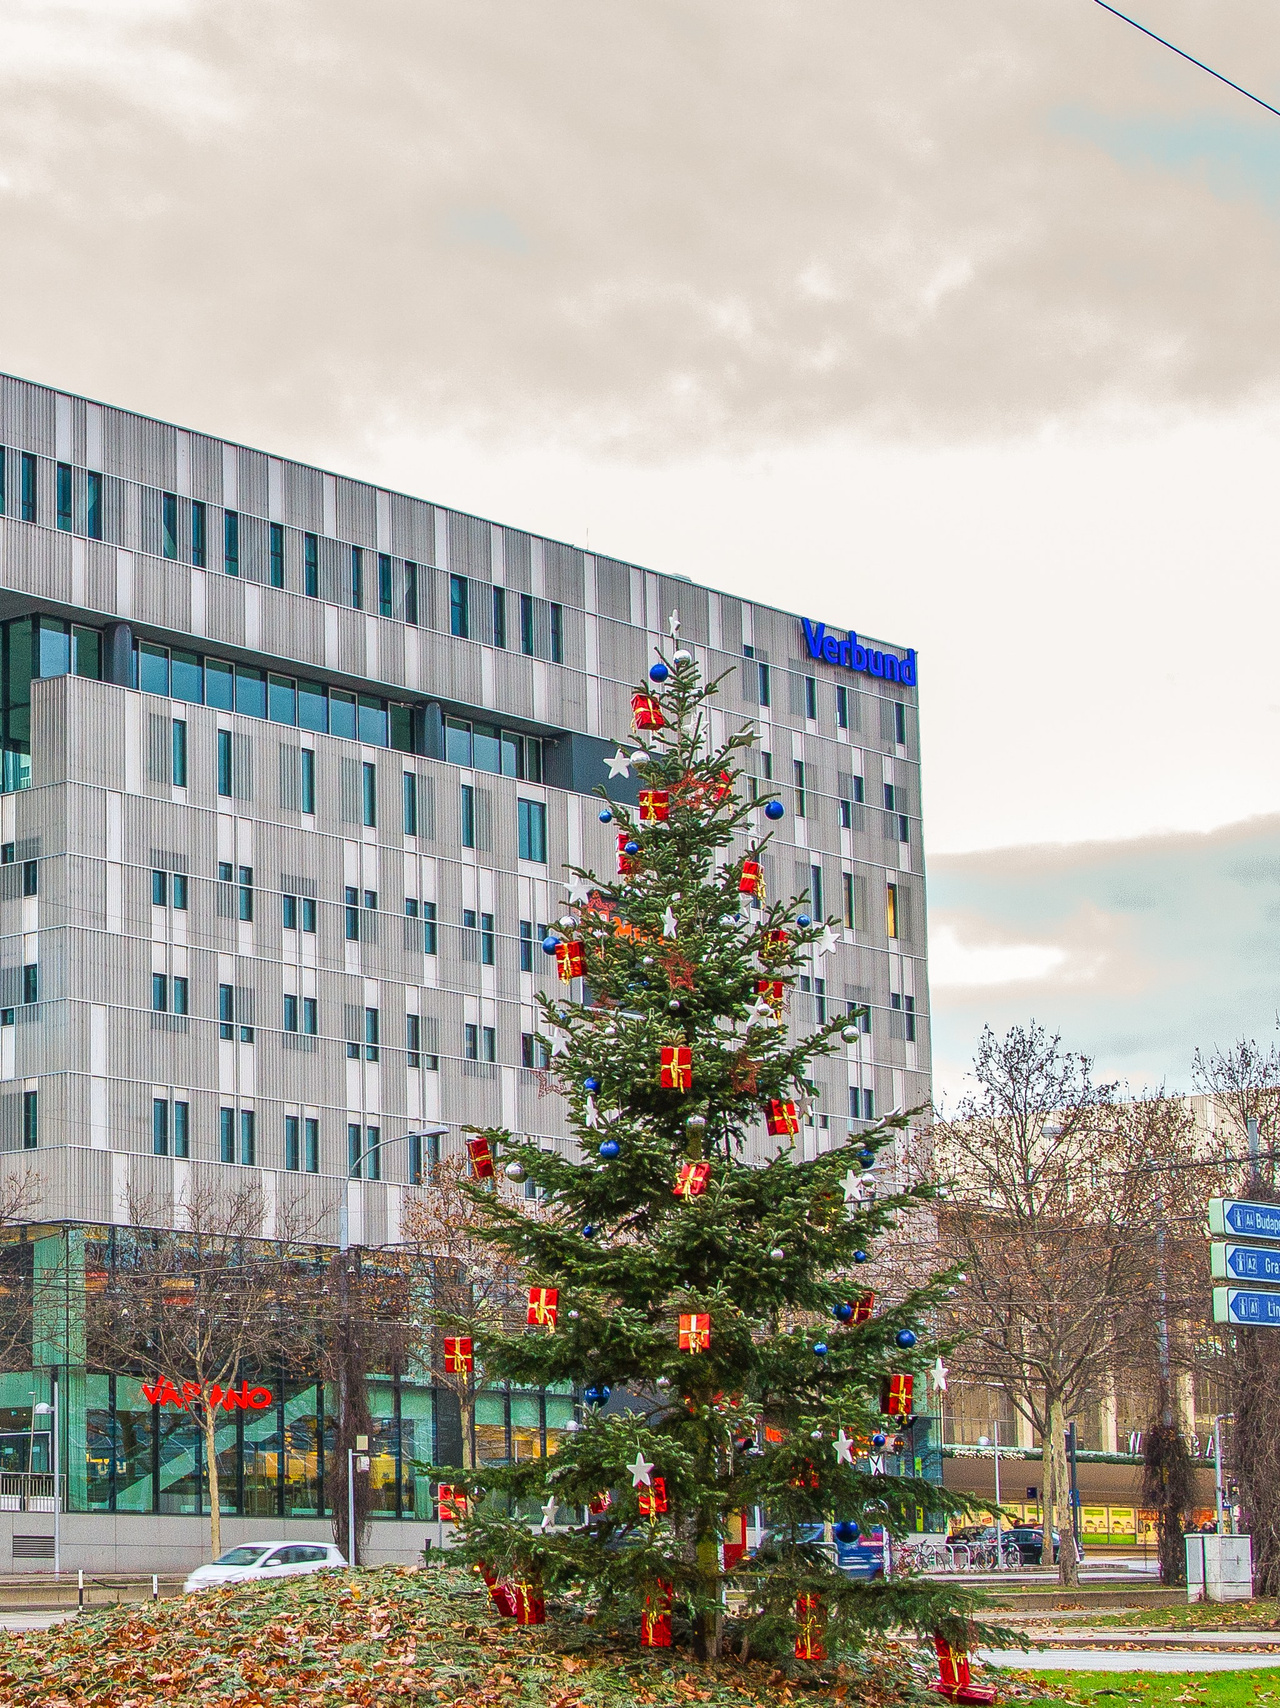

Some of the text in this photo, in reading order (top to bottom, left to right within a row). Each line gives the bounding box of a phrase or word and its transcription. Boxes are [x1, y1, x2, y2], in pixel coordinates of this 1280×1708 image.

[801, 616, 916, 687] Verbund
[1265, 1257, 1280, 1274] Gra
[142, 1374, 272, 1412] VAPANO
